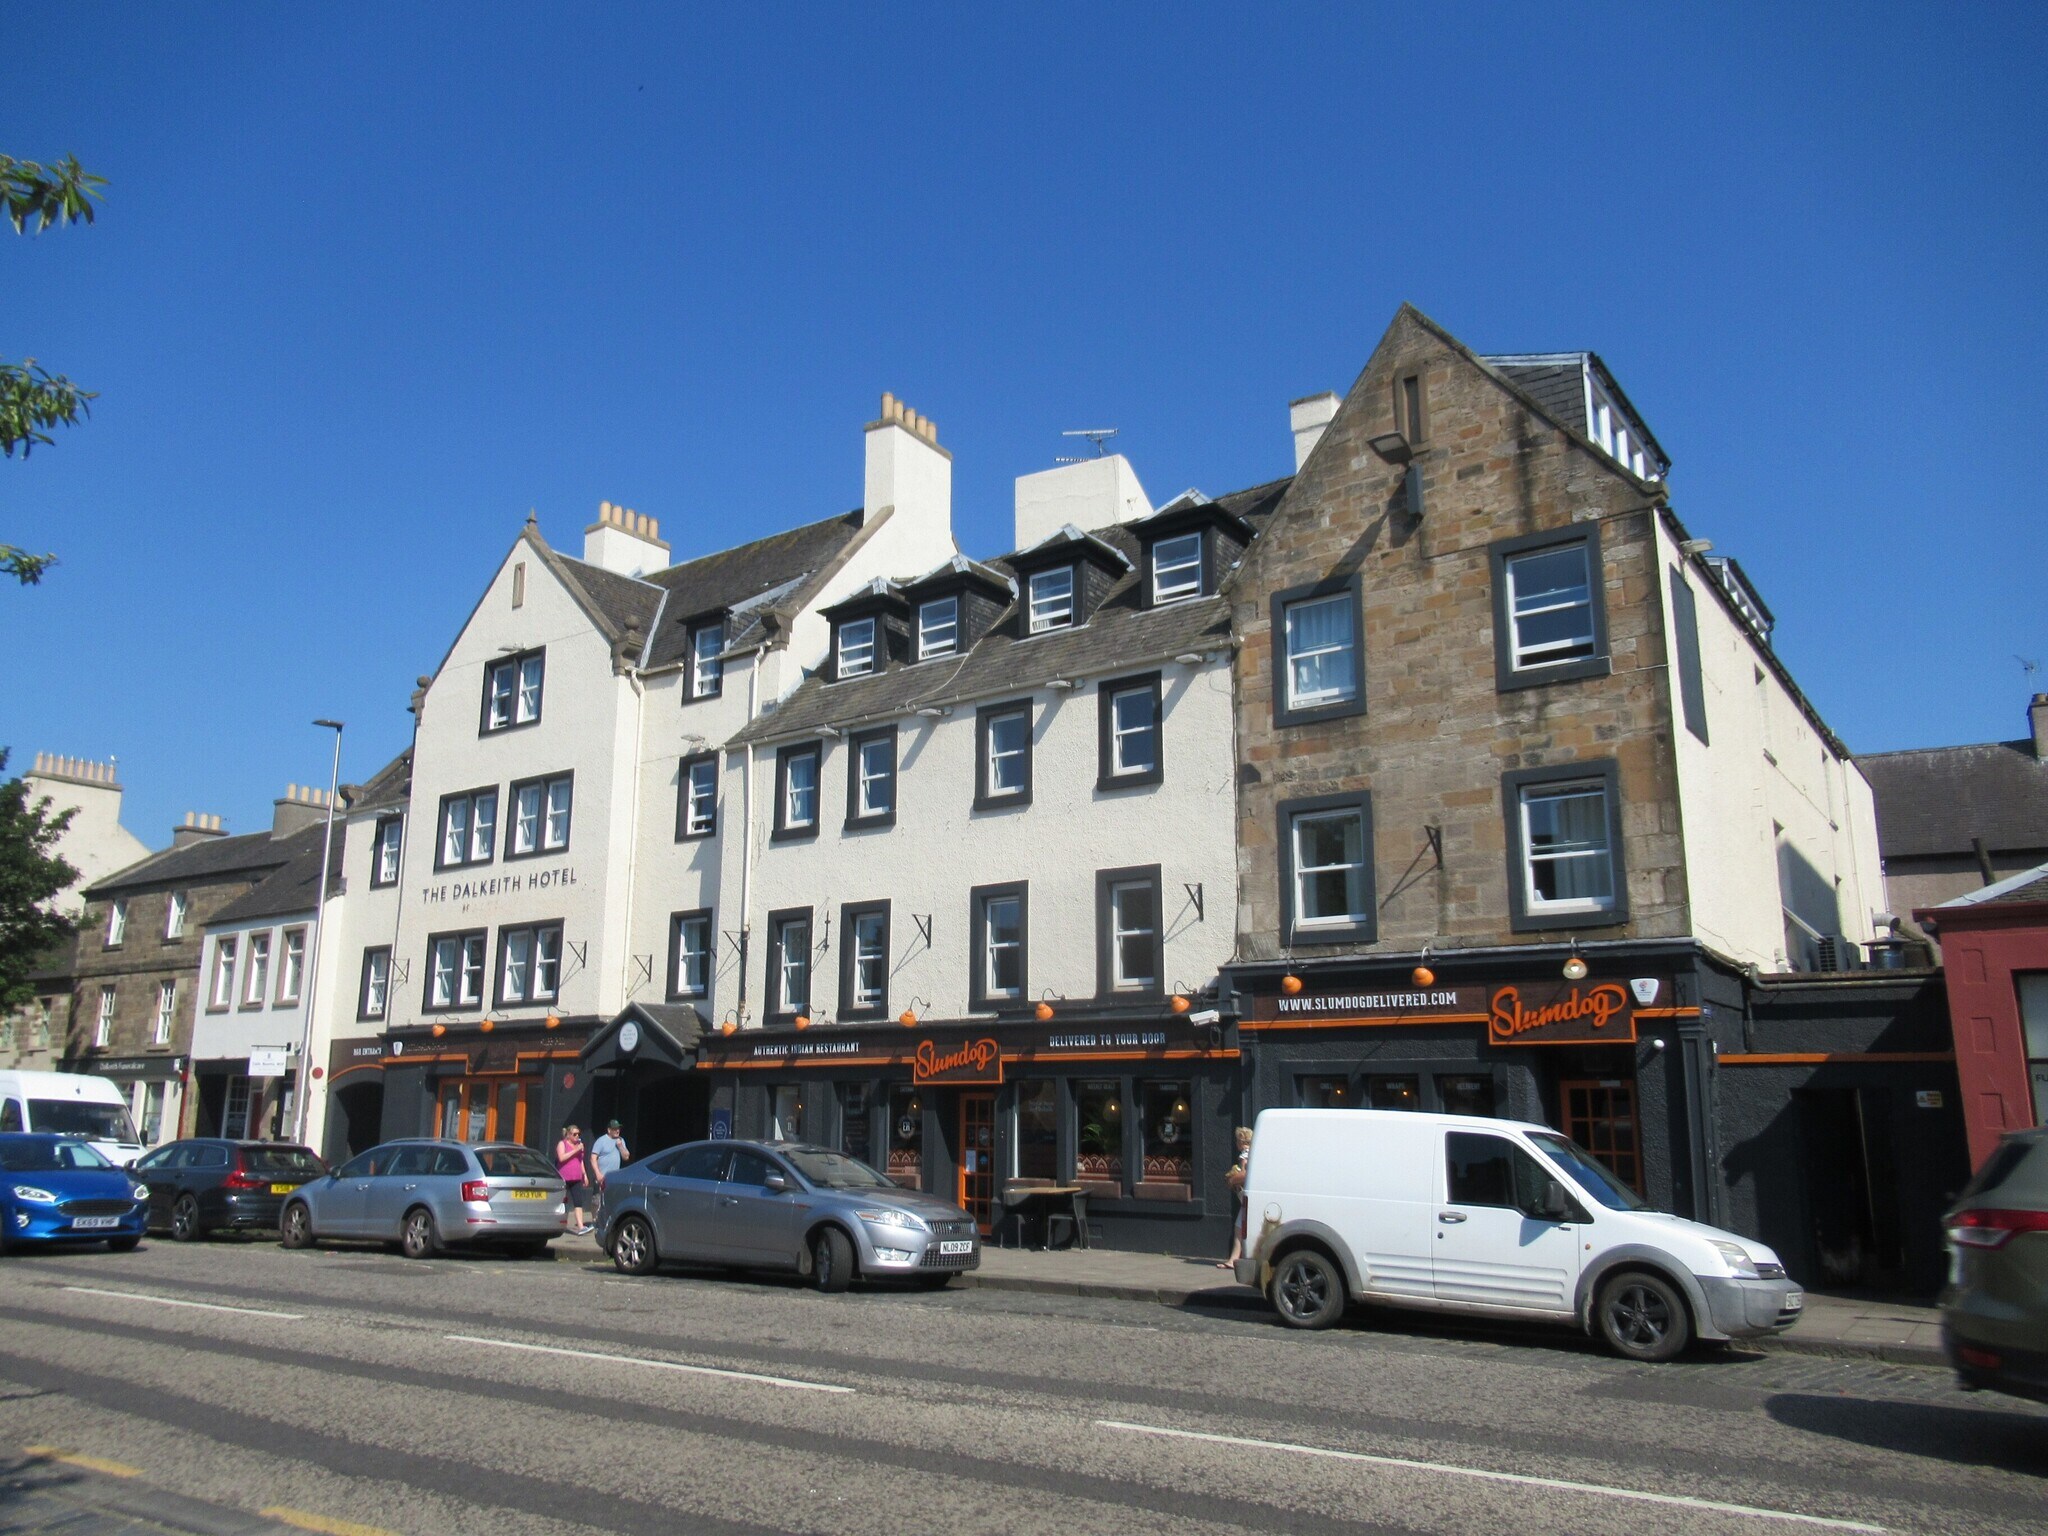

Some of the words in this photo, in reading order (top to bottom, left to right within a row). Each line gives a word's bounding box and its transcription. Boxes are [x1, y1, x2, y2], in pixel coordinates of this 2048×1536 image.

[423, 886, 448, 904] THE
[452, 875, 522, 900] DALKEITH
[528, 867, 578, 890] HOTEL
[1278, 991, 1457, 1012] WWW.SLUMDOGDELIVERED.COM
[1491, 983, 1627, 1037] Slumdog
[753, 1044, 789, 1056] AUTHENTIC
[791, 1043, 814, 1054] INDIAN
[815, 1041, 860, 1054] RESTAURANT
[1049, 1034, 1096, 1047] DELIVERED
[1100, 1034, 1111, 1046] TO
[1115, 1033, 1138, 1045] YOUR
[1142, 1032, 1166, 1045] DOOR
[916, 1037, 998, 1078] Slumdog
[942, 1242, 959, 1252] NL09
